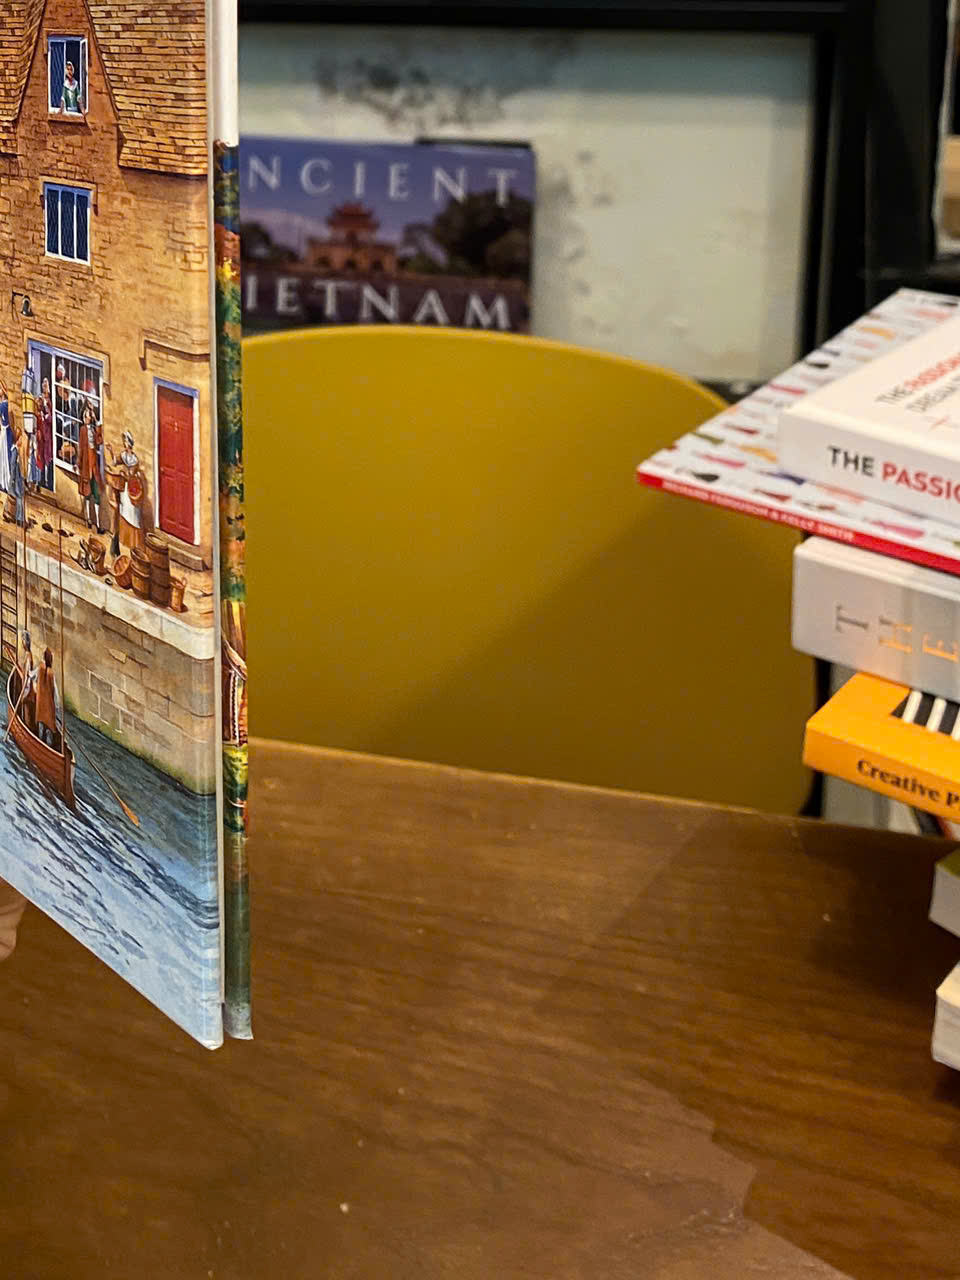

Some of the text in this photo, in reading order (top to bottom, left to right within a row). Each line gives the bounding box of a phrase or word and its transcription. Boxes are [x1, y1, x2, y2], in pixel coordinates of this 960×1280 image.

[247, 154, 517, 208] NCIENT
[244, 274, 512, 330] IETNAM
[826, 445, 875, 478] THE
[856, 758, 941, 803] Creative
